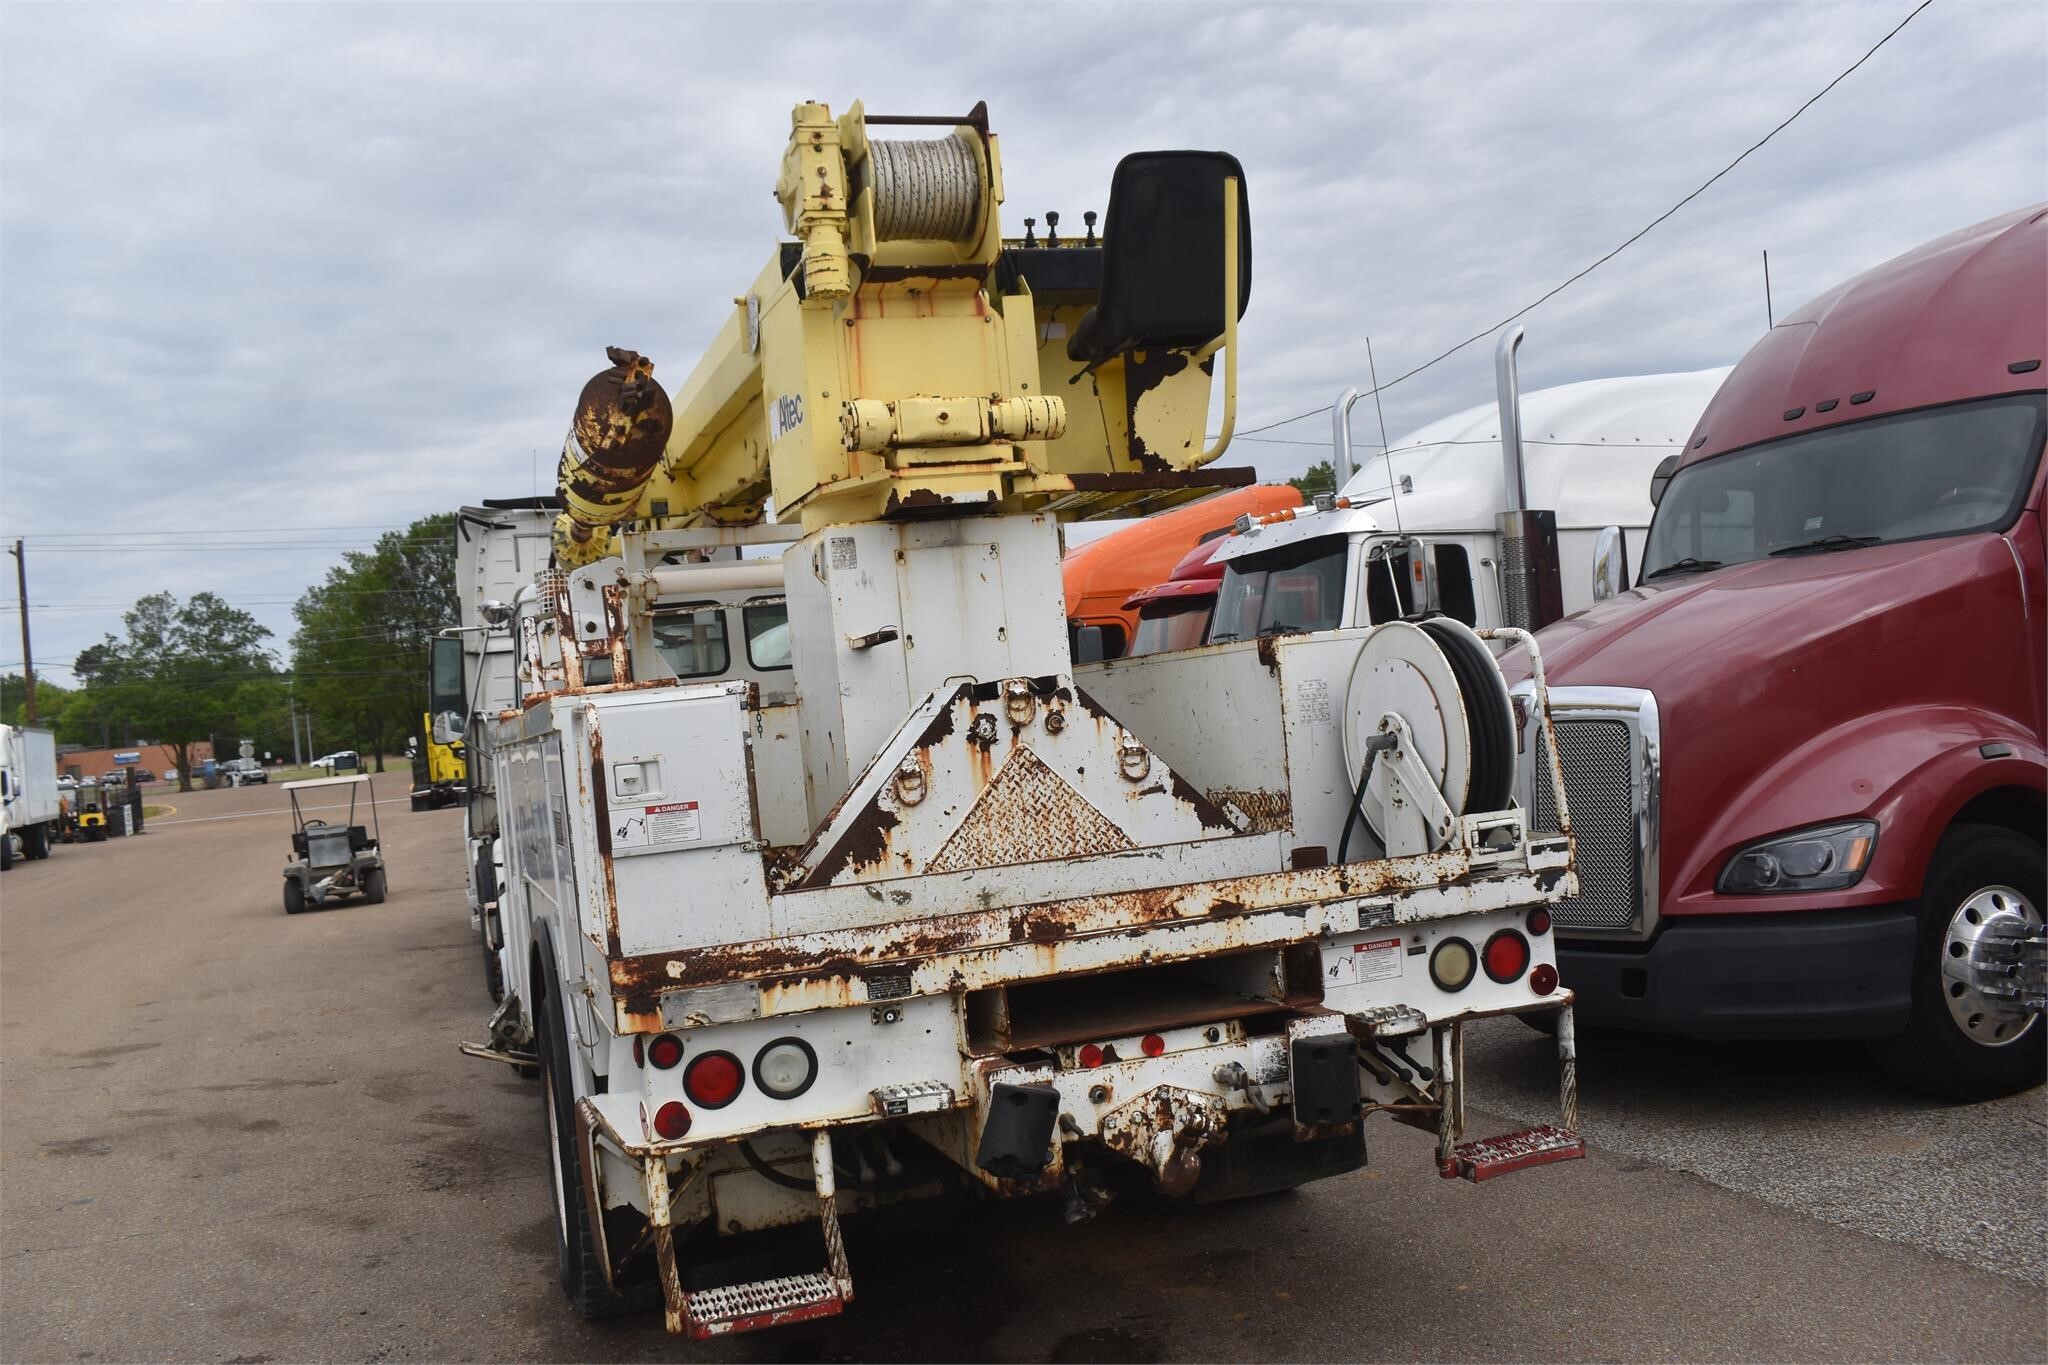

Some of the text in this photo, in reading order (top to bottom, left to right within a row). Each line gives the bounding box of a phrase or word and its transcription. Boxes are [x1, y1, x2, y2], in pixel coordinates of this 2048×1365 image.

[779, 394, 803, 437] Altec
[661, 803, 689, 813] DANGER
[1368, 940, 1393, 950] DANGER
